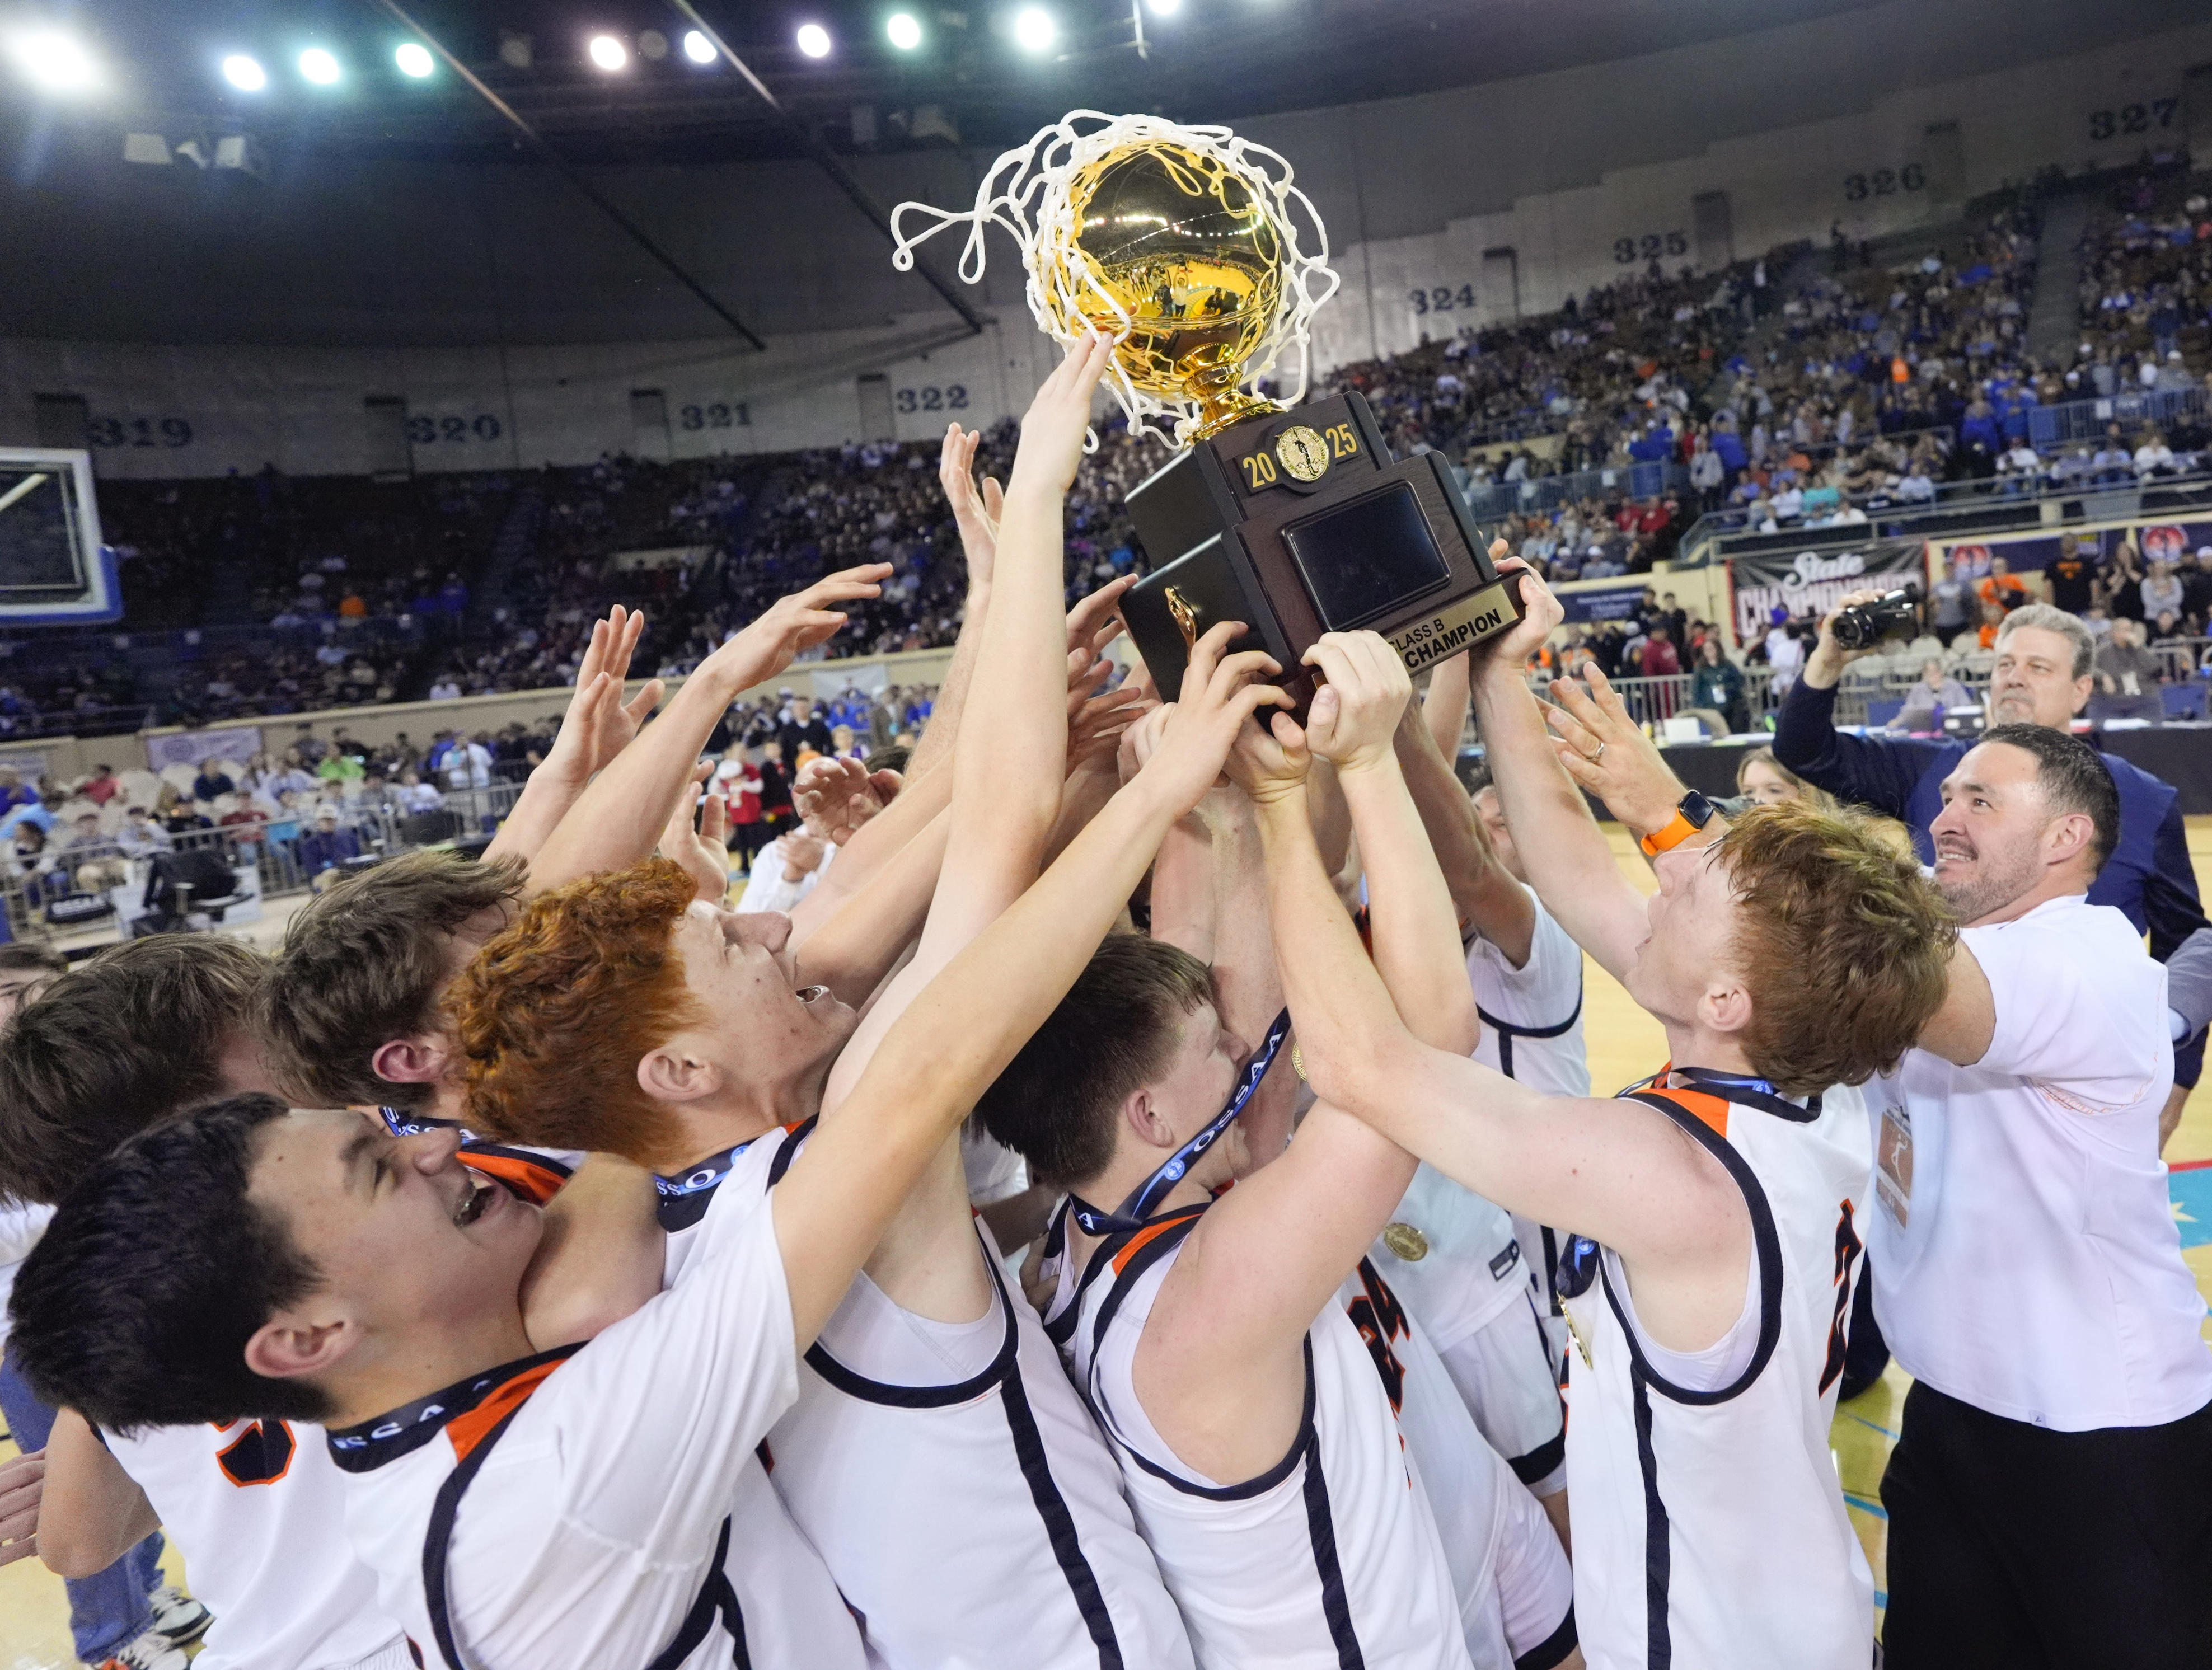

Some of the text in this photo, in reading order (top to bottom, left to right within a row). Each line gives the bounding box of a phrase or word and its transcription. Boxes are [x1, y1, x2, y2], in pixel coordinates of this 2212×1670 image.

[2089, 98, 2177, 140] 327
[1614, 231, 1687, 263] 325
[1409, 284, 1475, 315] 324
[897, 384, 969, 413] 322
[406, 415, 500, 444] 320
[681, 403, 751, 430] 321
[86, 418, 193, 447] 319
[1243, 452, 1276, 487] 20
[1325, 424, 1357, 458] 25
[1404, 608, 1502, 668] CHAMPION
[1433, 618, 1444, 632] B
[1193, 1032, 1282, 1152] OSSAA
